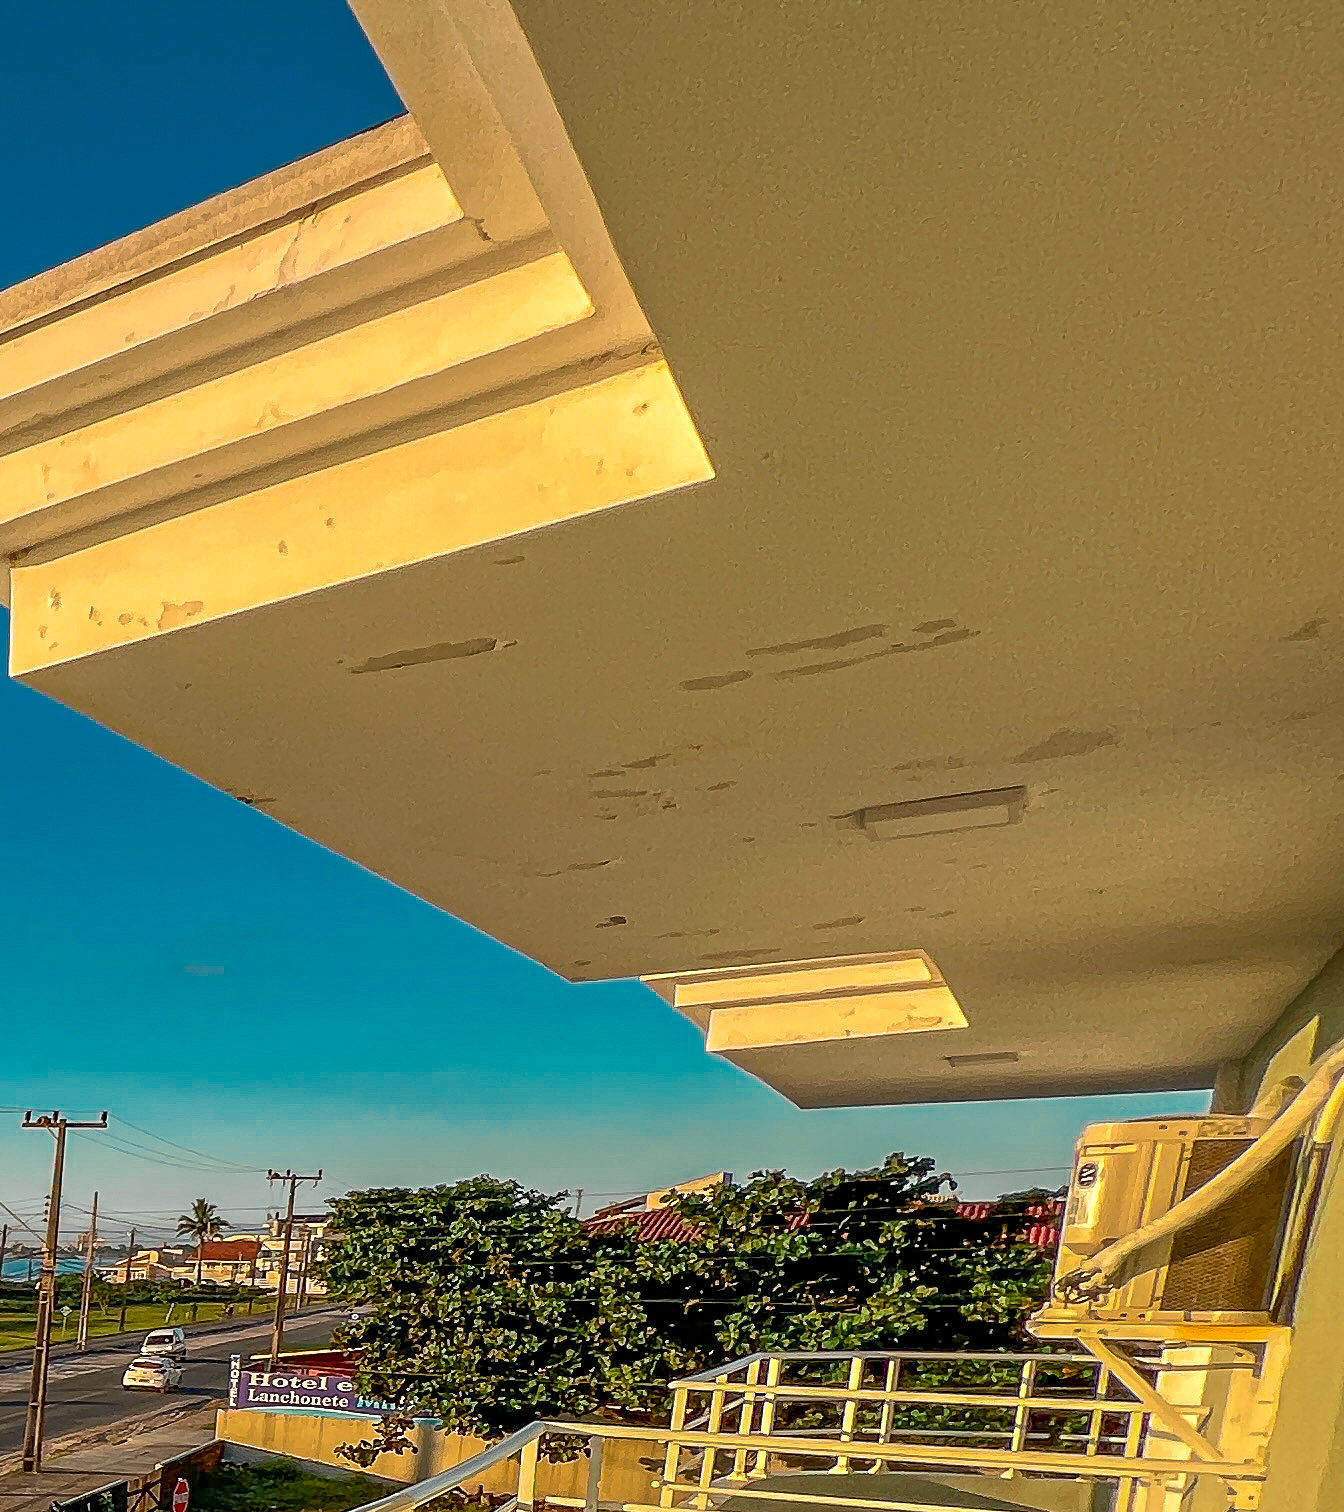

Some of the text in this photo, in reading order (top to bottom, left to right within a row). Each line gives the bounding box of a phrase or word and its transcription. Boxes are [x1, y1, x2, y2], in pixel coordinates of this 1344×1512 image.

[248, 1372, 353, 1392] Hotel e
[248, 1388, 349, 1408] Lanchonete
